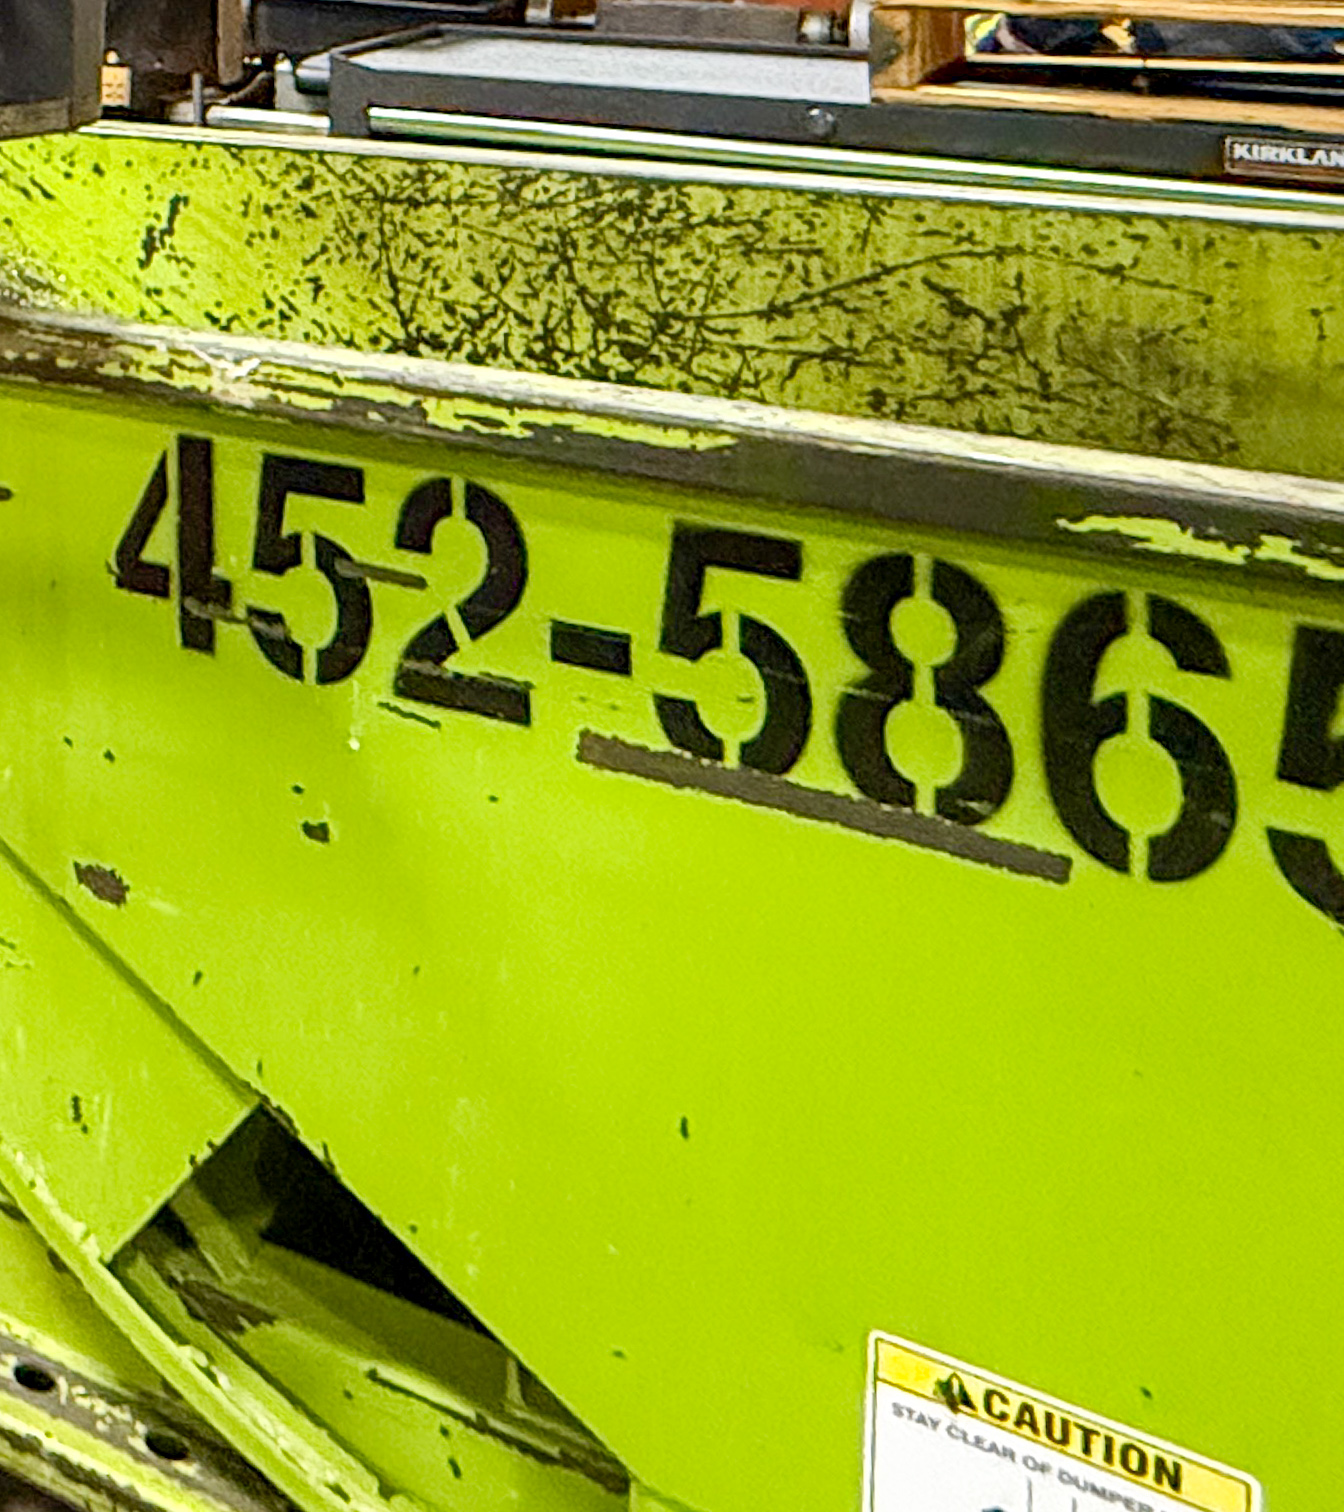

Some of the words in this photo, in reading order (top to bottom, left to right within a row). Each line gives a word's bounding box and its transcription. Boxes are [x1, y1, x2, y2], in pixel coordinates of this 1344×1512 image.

[891, 1401, 942, 1431] STAY
[945, 1423, 1016, 1463] CLEAR
[983, 1388, 1183, 1495] CAUTION
